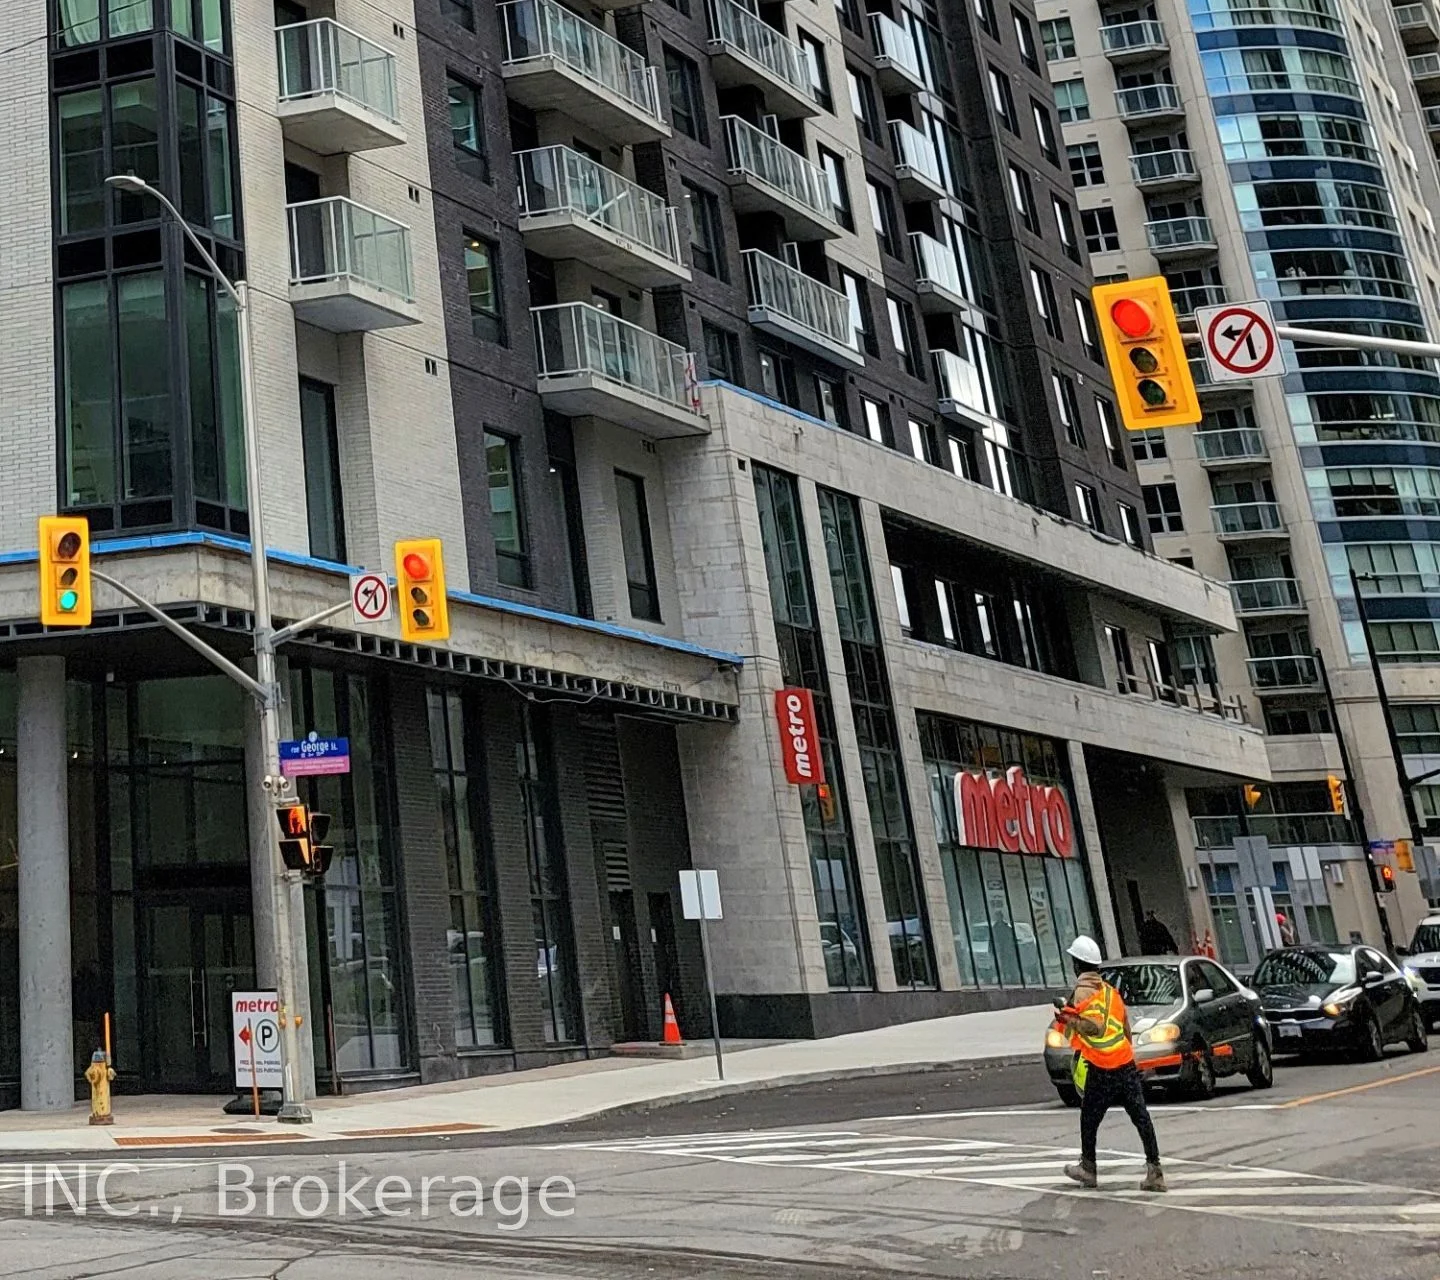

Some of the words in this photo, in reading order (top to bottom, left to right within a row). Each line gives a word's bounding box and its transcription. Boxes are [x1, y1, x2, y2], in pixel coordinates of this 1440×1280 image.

[301, 740, 329, 753] George
[787, 694, 811, 778] metro
[954, 766, 1074, 858] metro
[235, 999, 279, 1012] metro
[262, 1025, 272, 1046] P
